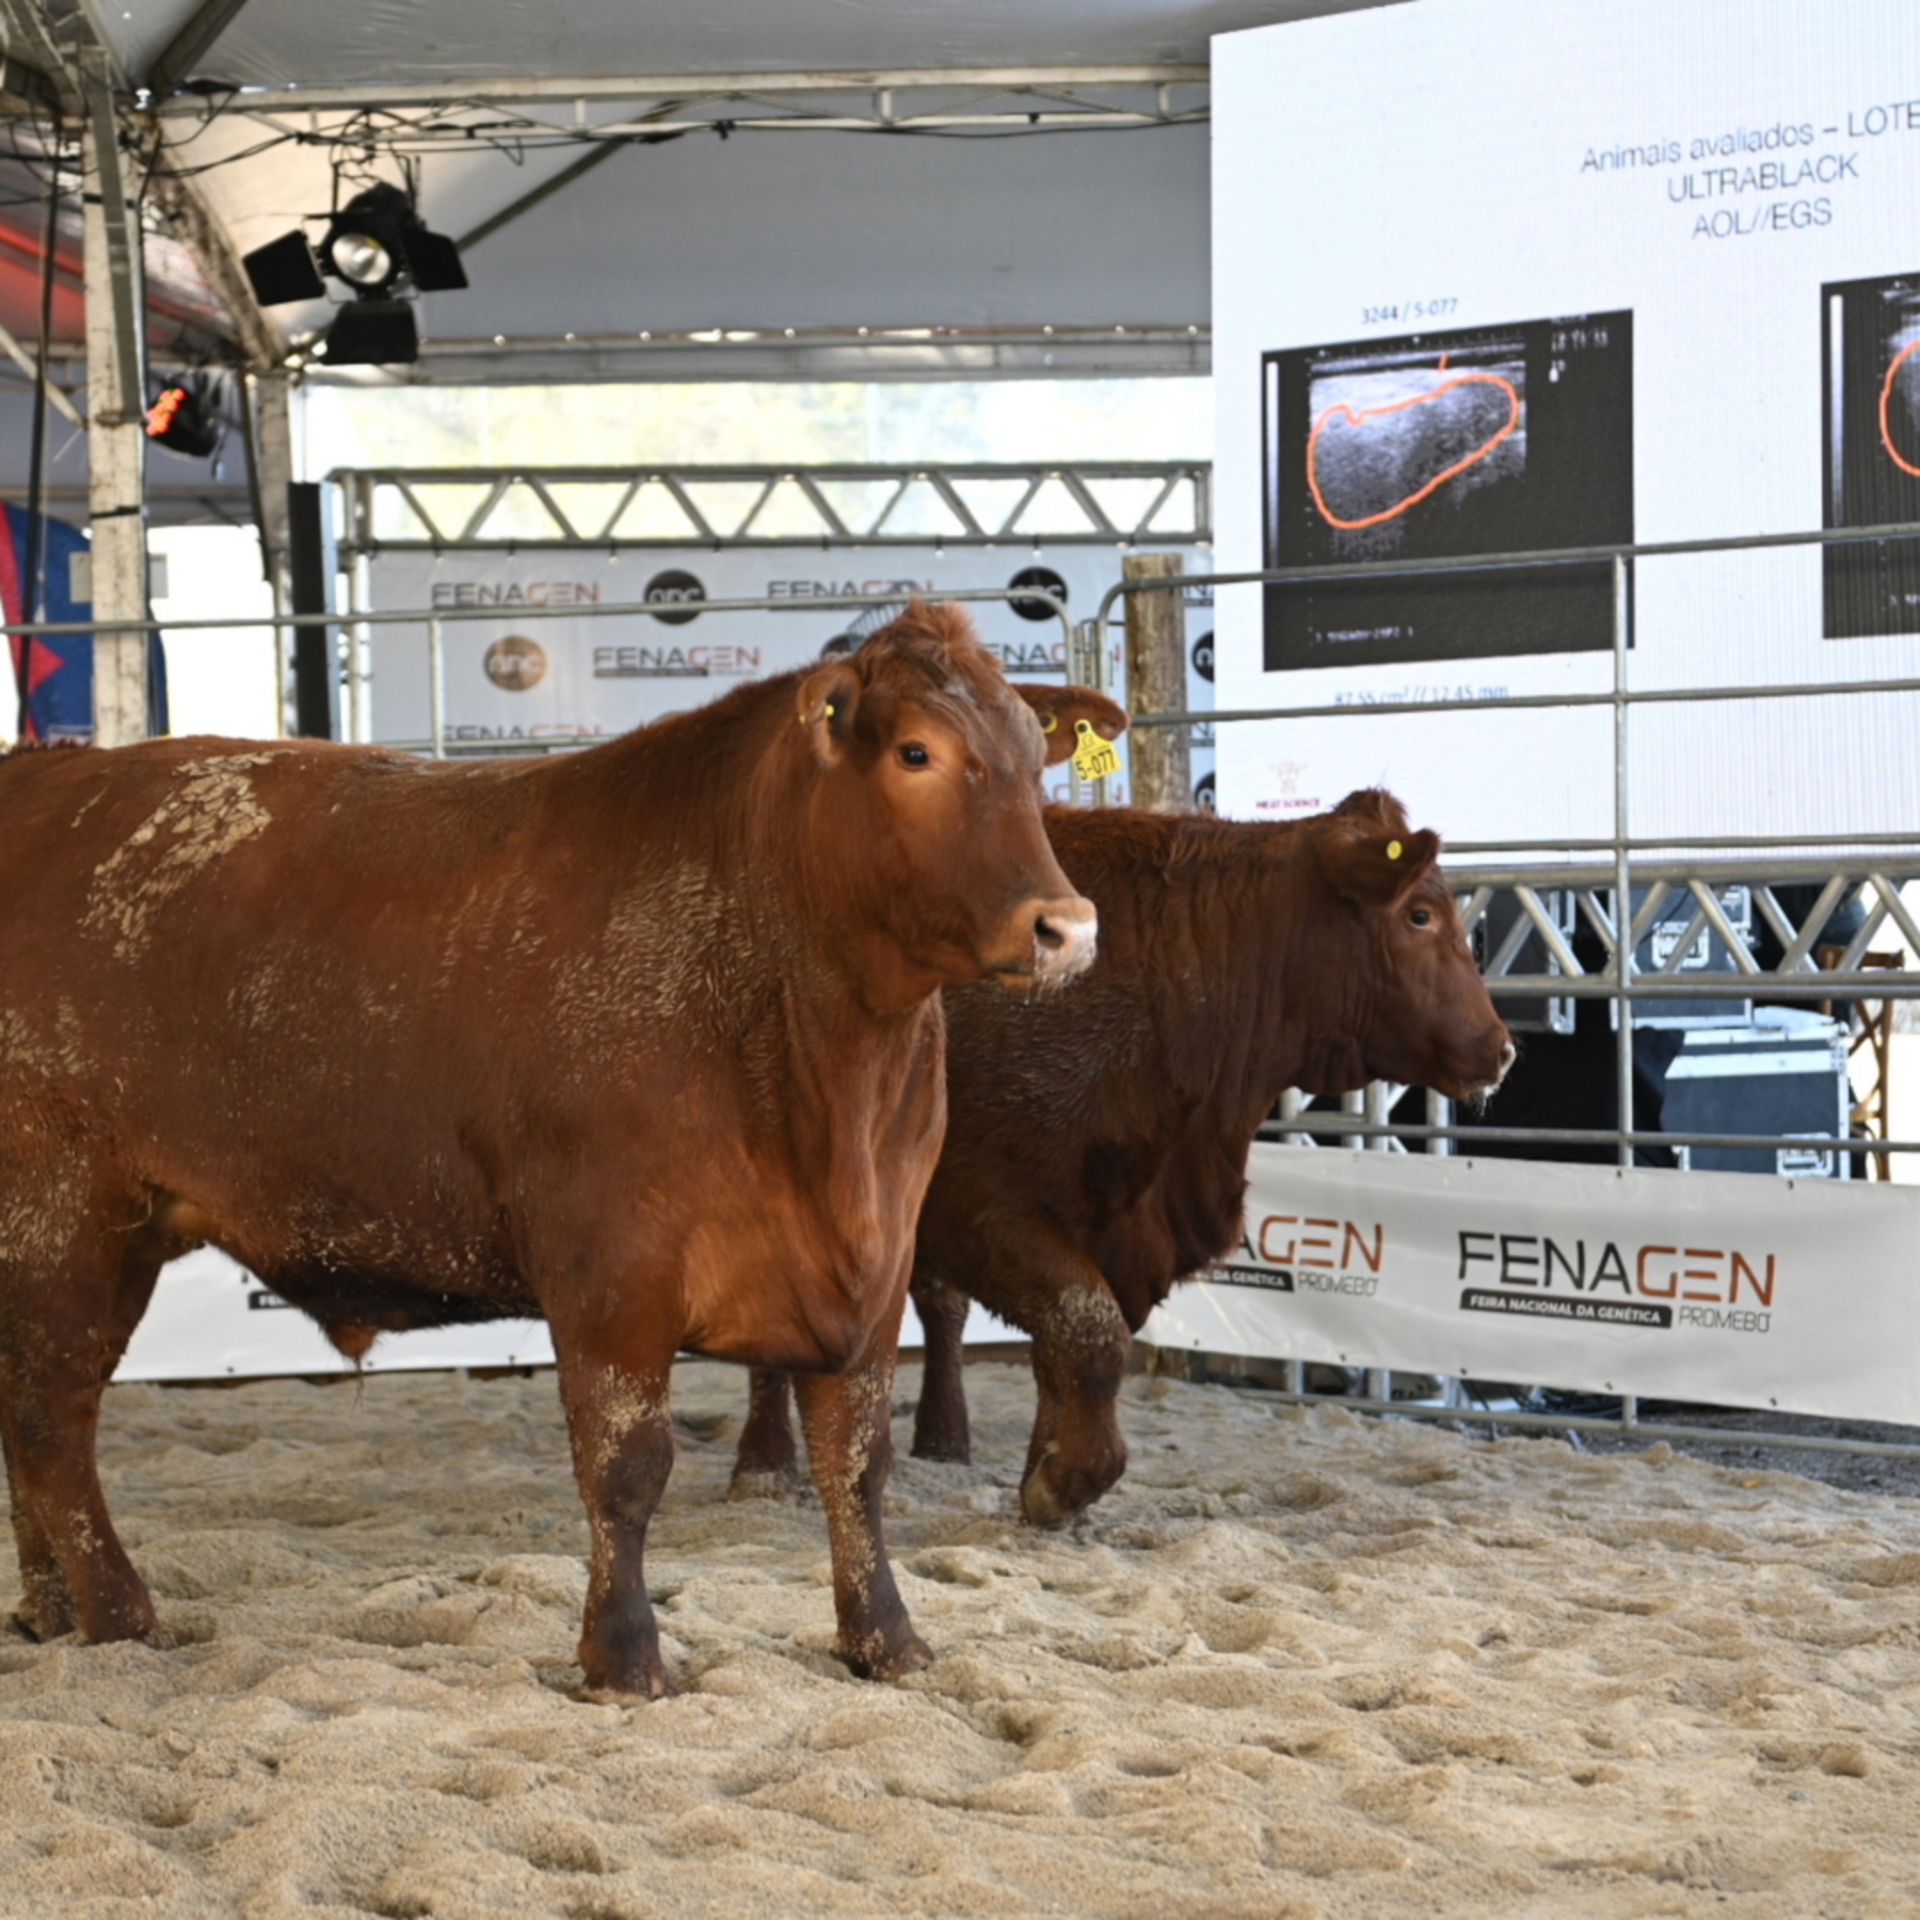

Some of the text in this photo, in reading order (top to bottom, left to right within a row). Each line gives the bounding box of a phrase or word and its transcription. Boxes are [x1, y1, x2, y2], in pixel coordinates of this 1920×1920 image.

[1580, 138, 1682, 172] Animais
[1690, 122, 1814, 160] avaliados
[1848, 100, 1920, 137] LOTE
[1668, 153, 1859, 202] ULTRABLACK
[1692, 198, 1833, 239] AOL//EGS
[432, 582, 600, 605] FENAGEN
[593, 646, 761, 668] FENAGEN
[1334, 690, 1376, 706] 8755
[1432, 685, 1473, 701] 1245
[1075, 749, 1115, 780] 5-077
[1458, 1231, 1776, 1306] FENAGEN
[1469, 1294, 1661, 1324] FEIRA NACIONAL DA GENÉTICA
[1678, 1305, 1772, 1333] PROMEBO
